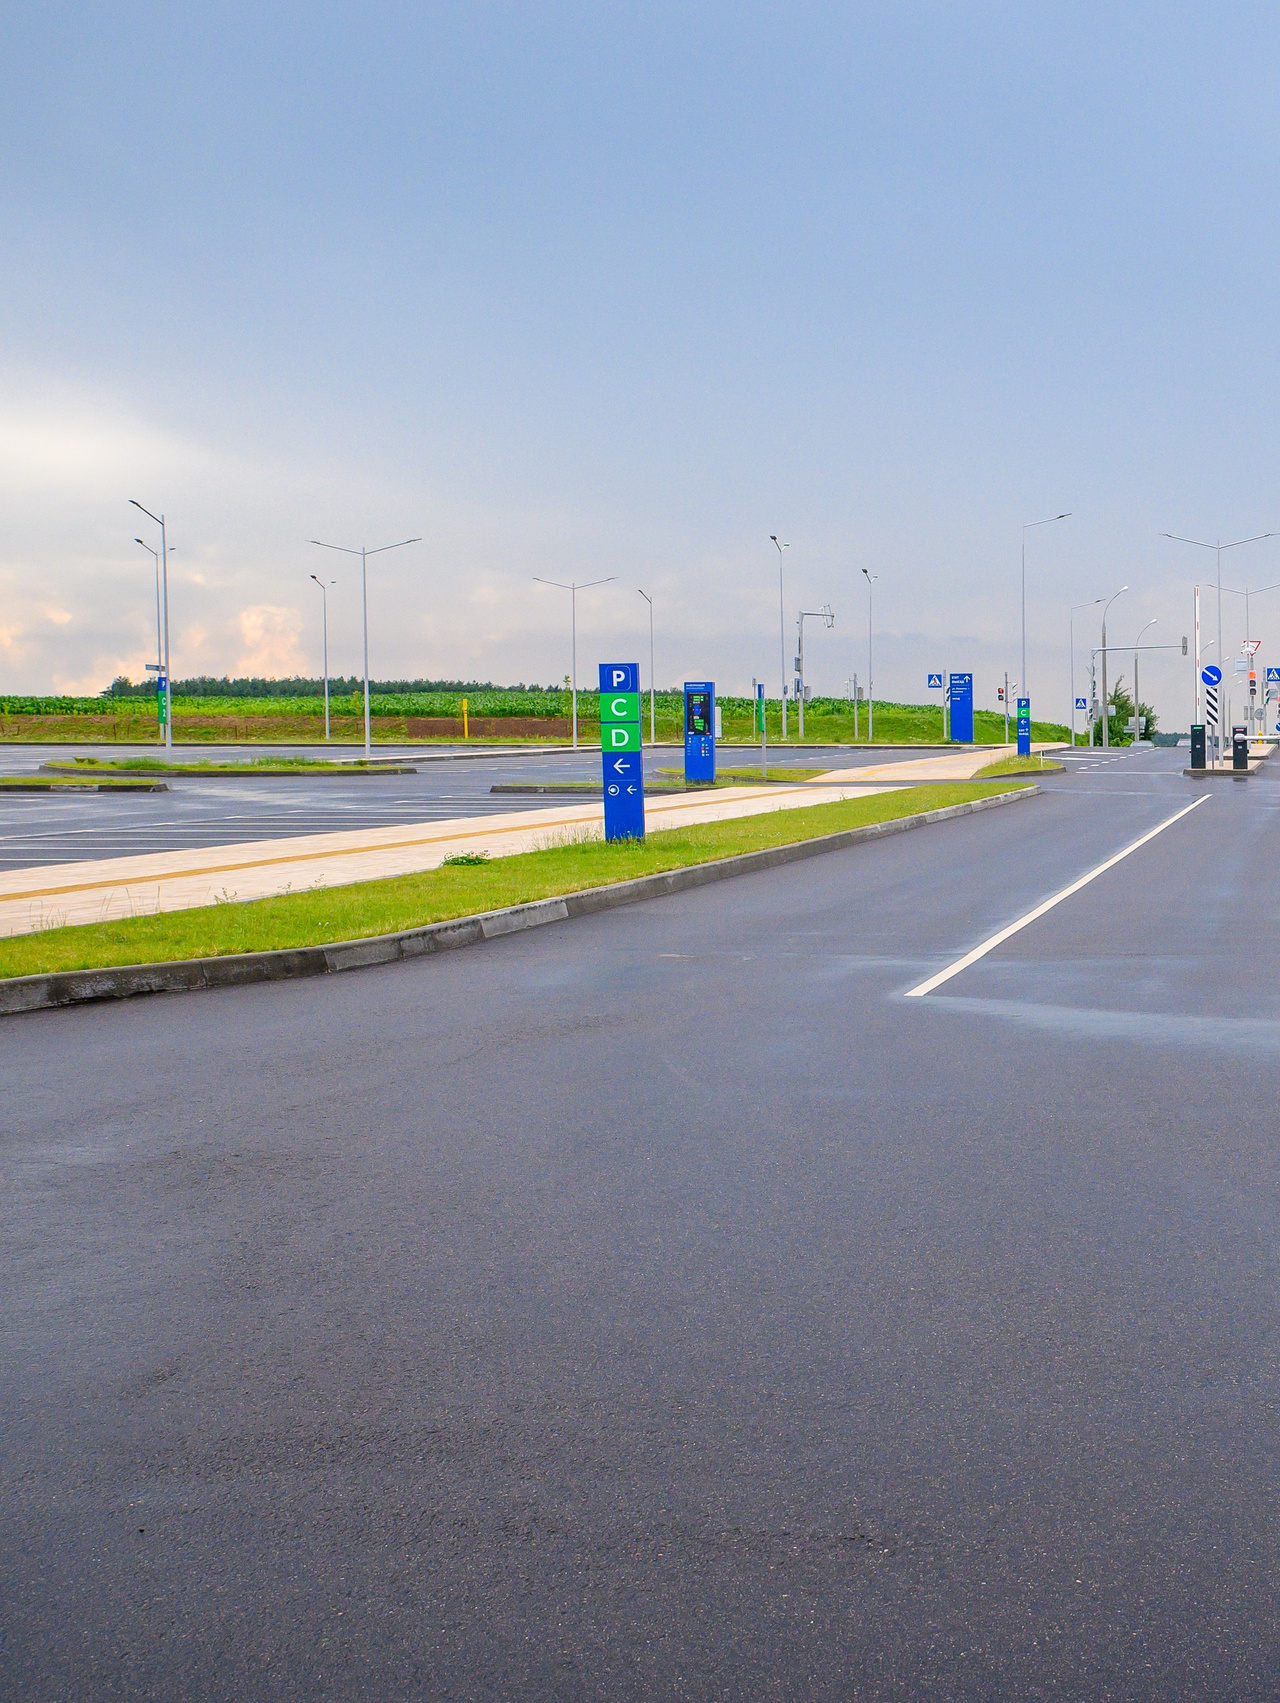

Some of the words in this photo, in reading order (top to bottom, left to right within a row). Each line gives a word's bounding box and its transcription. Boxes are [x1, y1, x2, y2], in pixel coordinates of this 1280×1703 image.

[612, 670, 626, 687] P
[611, 698, 628, 717] C
[611, 729, 629, 747] D
